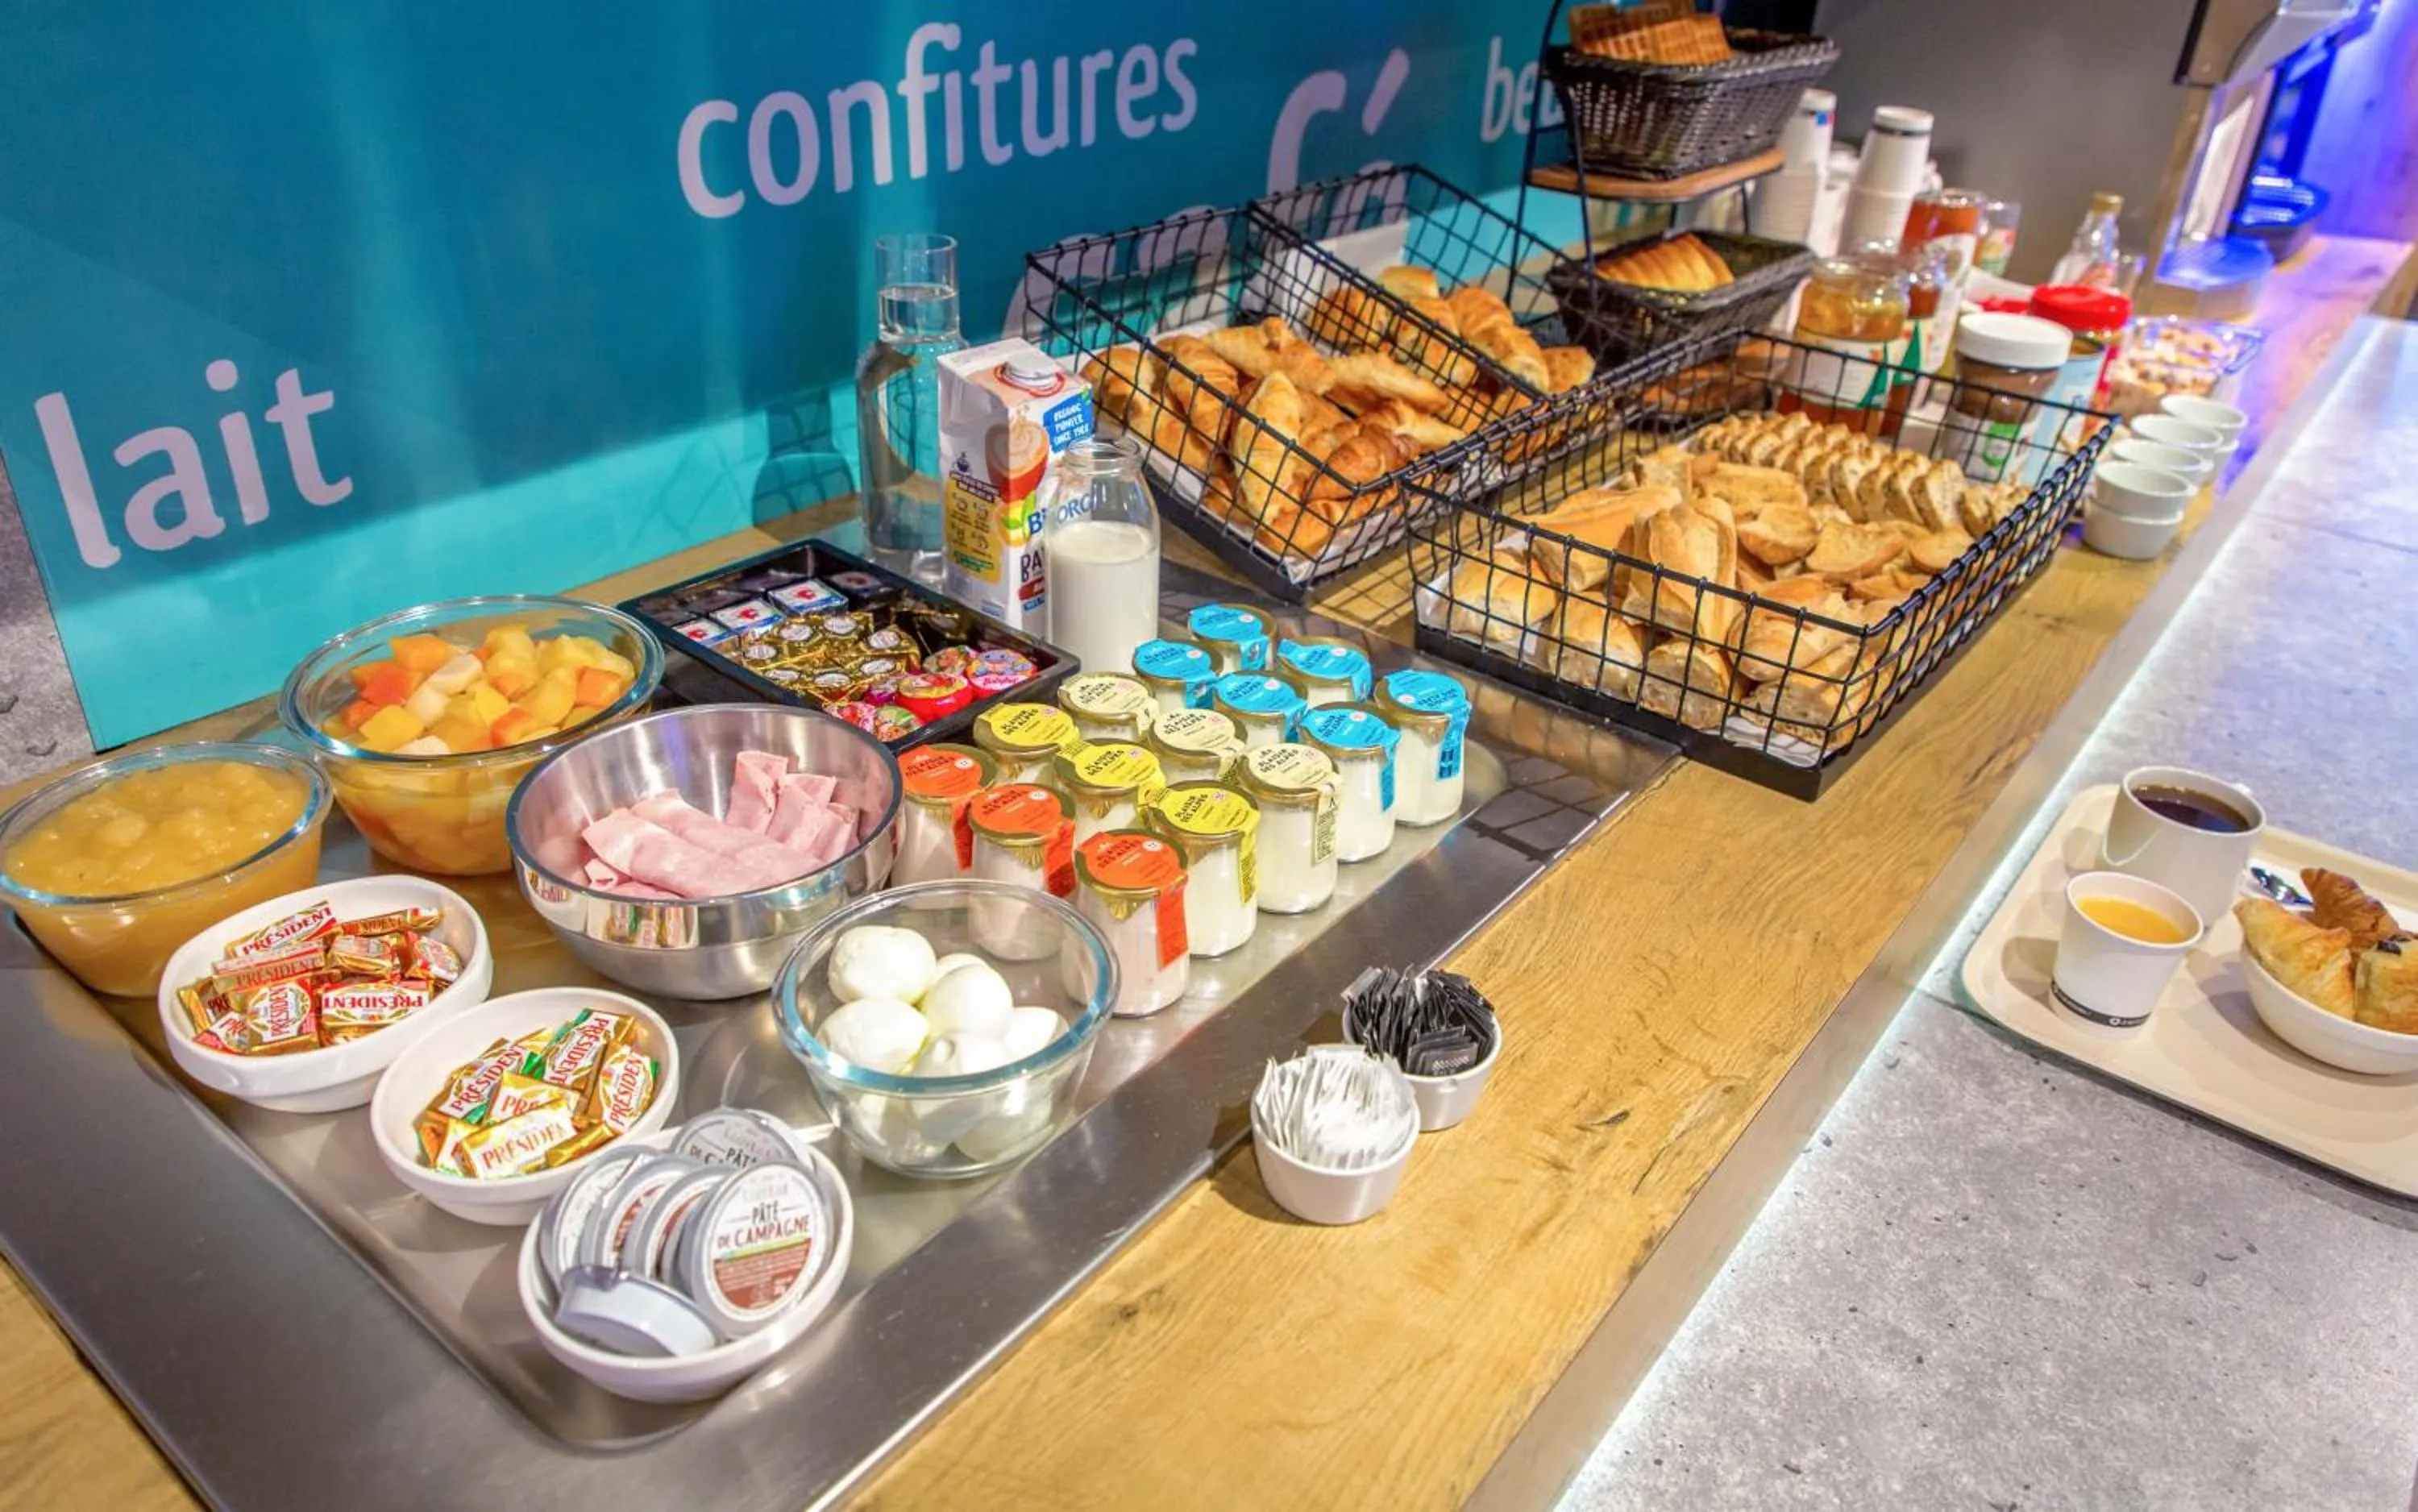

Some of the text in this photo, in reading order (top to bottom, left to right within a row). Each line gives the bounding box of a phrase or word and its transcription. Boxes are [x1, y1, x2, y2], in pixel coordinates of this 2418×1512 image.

[678, 22, 1198, 218] confitures
[34, 359, 353, 568] lait
[734, 1215, 810, 1248] CAMPAGNE
